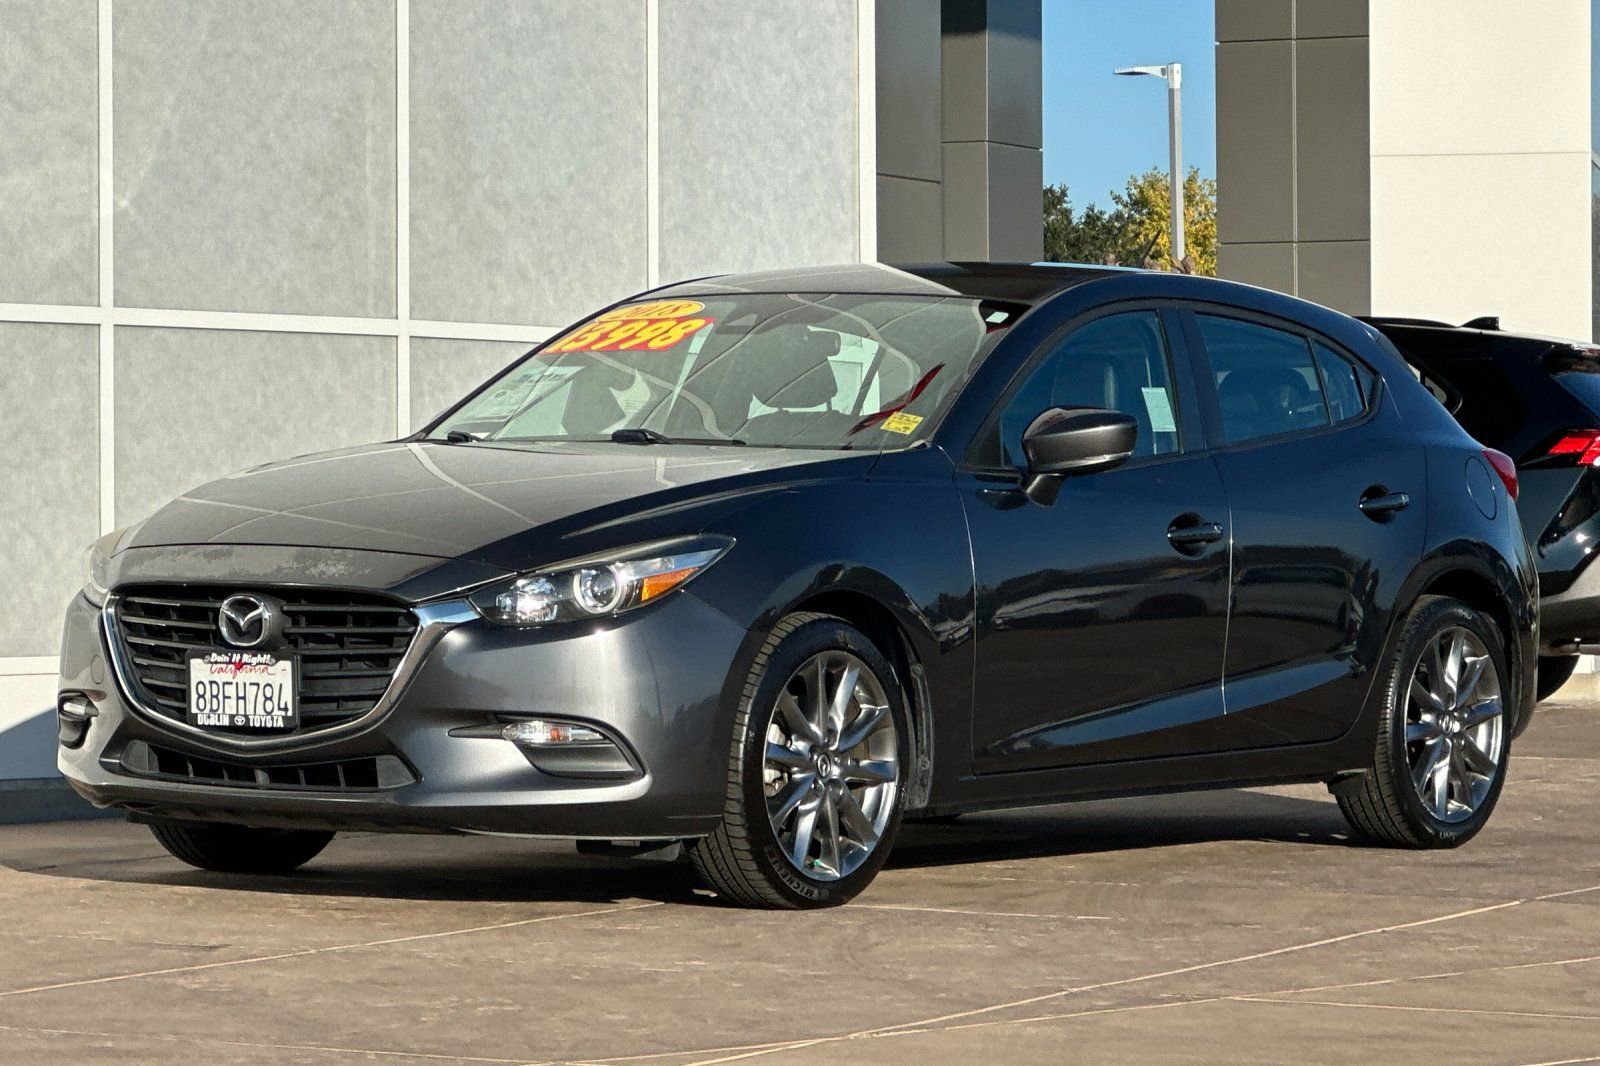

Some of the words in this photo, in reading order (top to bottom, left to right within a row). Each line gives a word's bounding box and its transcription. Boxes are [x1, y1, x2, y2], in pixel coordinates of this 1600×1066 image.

[209, 663, 276, 679] California
[195, 680, 290, 716] 8BFH784
[197, 713, 230, 726] DUBLIN
[248, 715, 284, 728] TOYOTA
